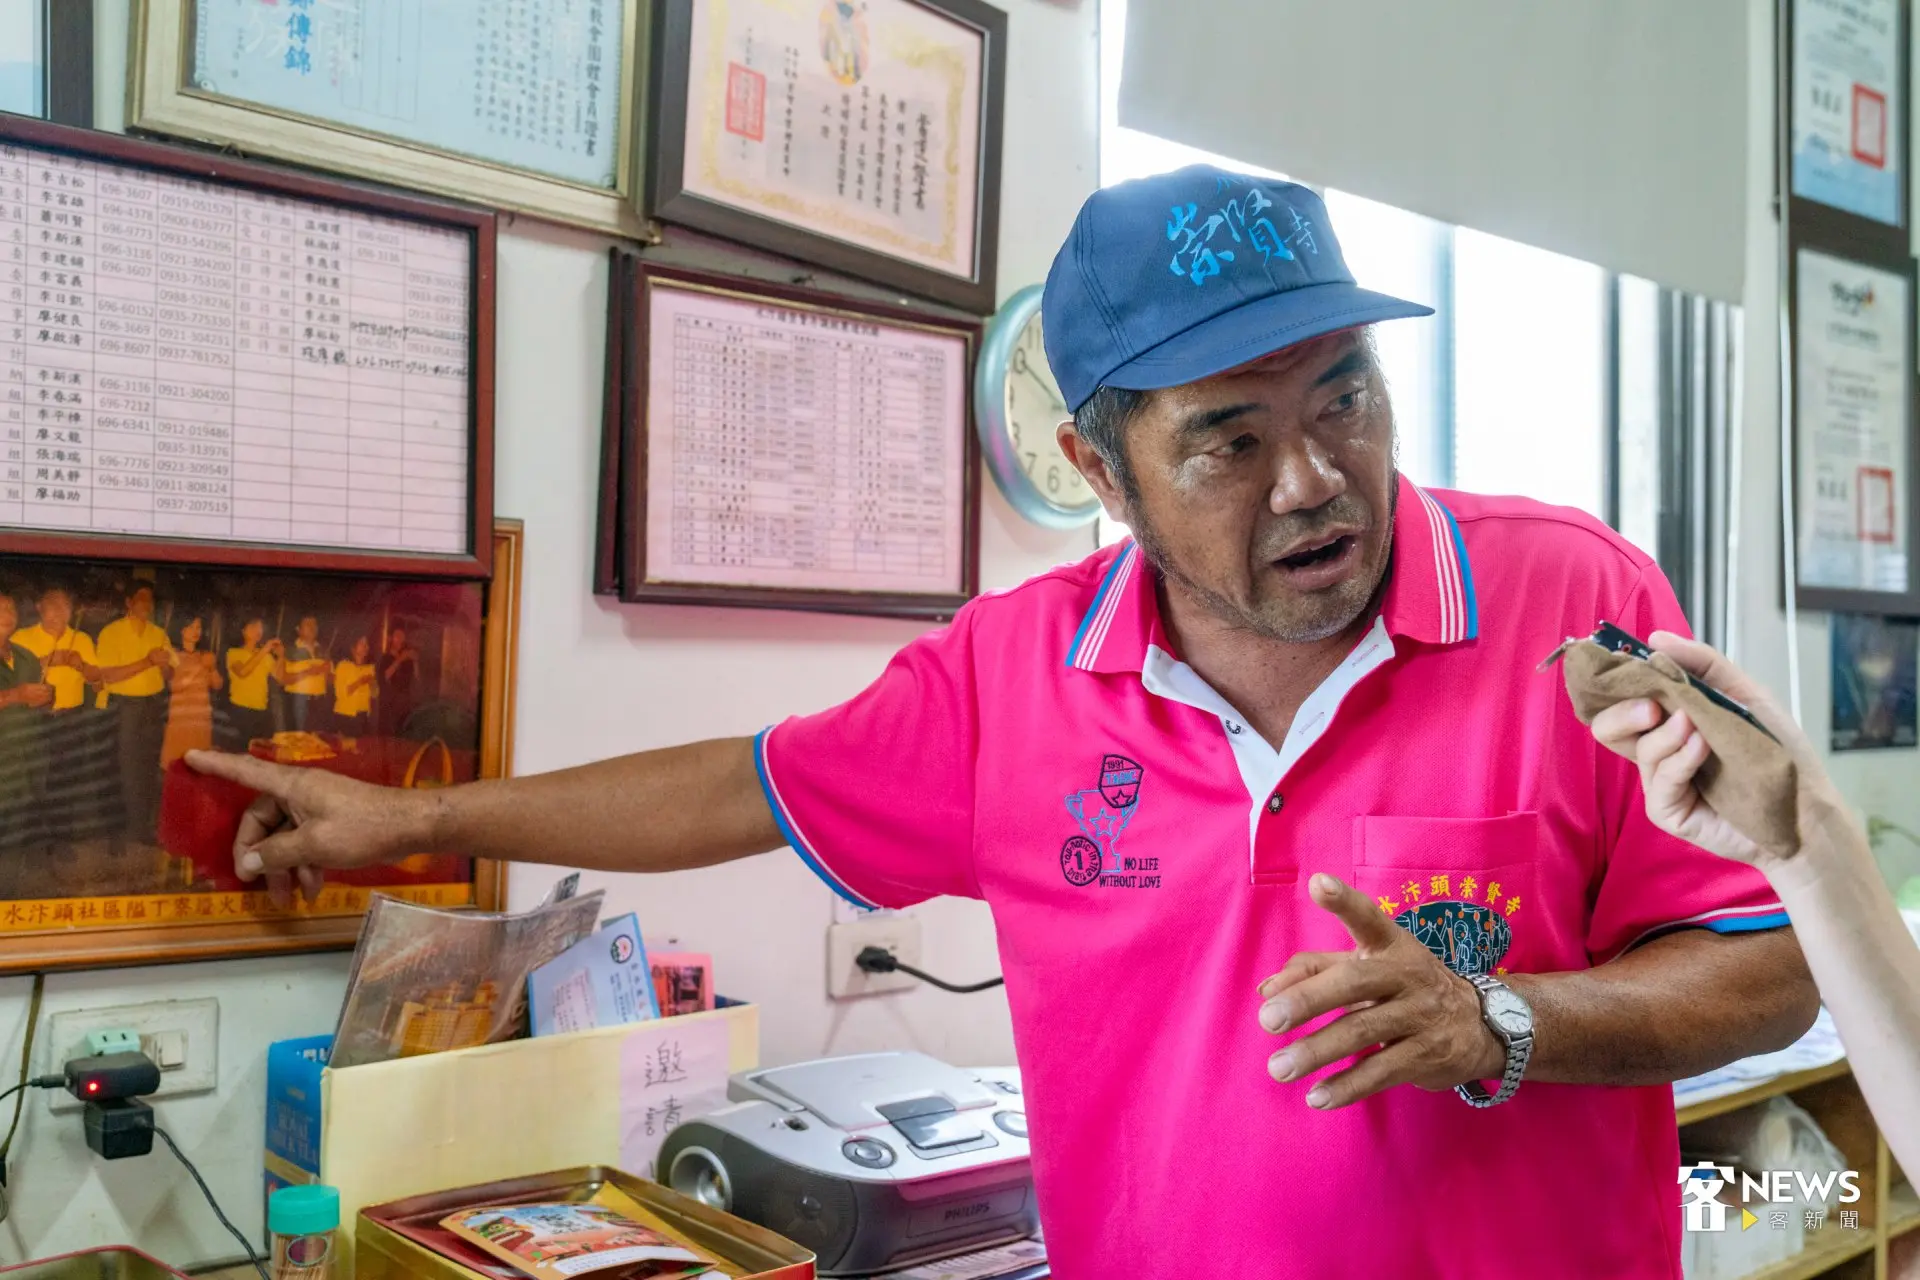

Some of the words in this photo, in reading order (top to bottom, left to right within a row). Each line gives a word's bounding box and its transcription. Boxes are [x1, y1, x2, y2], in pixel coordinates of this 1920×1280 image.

[1025, 452, 1038, 476] 7
[1047, 466, 1061, 494] 6
[1074, 851, 1083, 870] 1
[1124, 858, 1136, 870] NO
[1138, 858, 1159, 870] LIFE
[1099, 876, 1137, 888] WITHOUT
[1138, 876, 1161, 888] LOVE
[944, 1202, 990, 1220] PHILIPS
